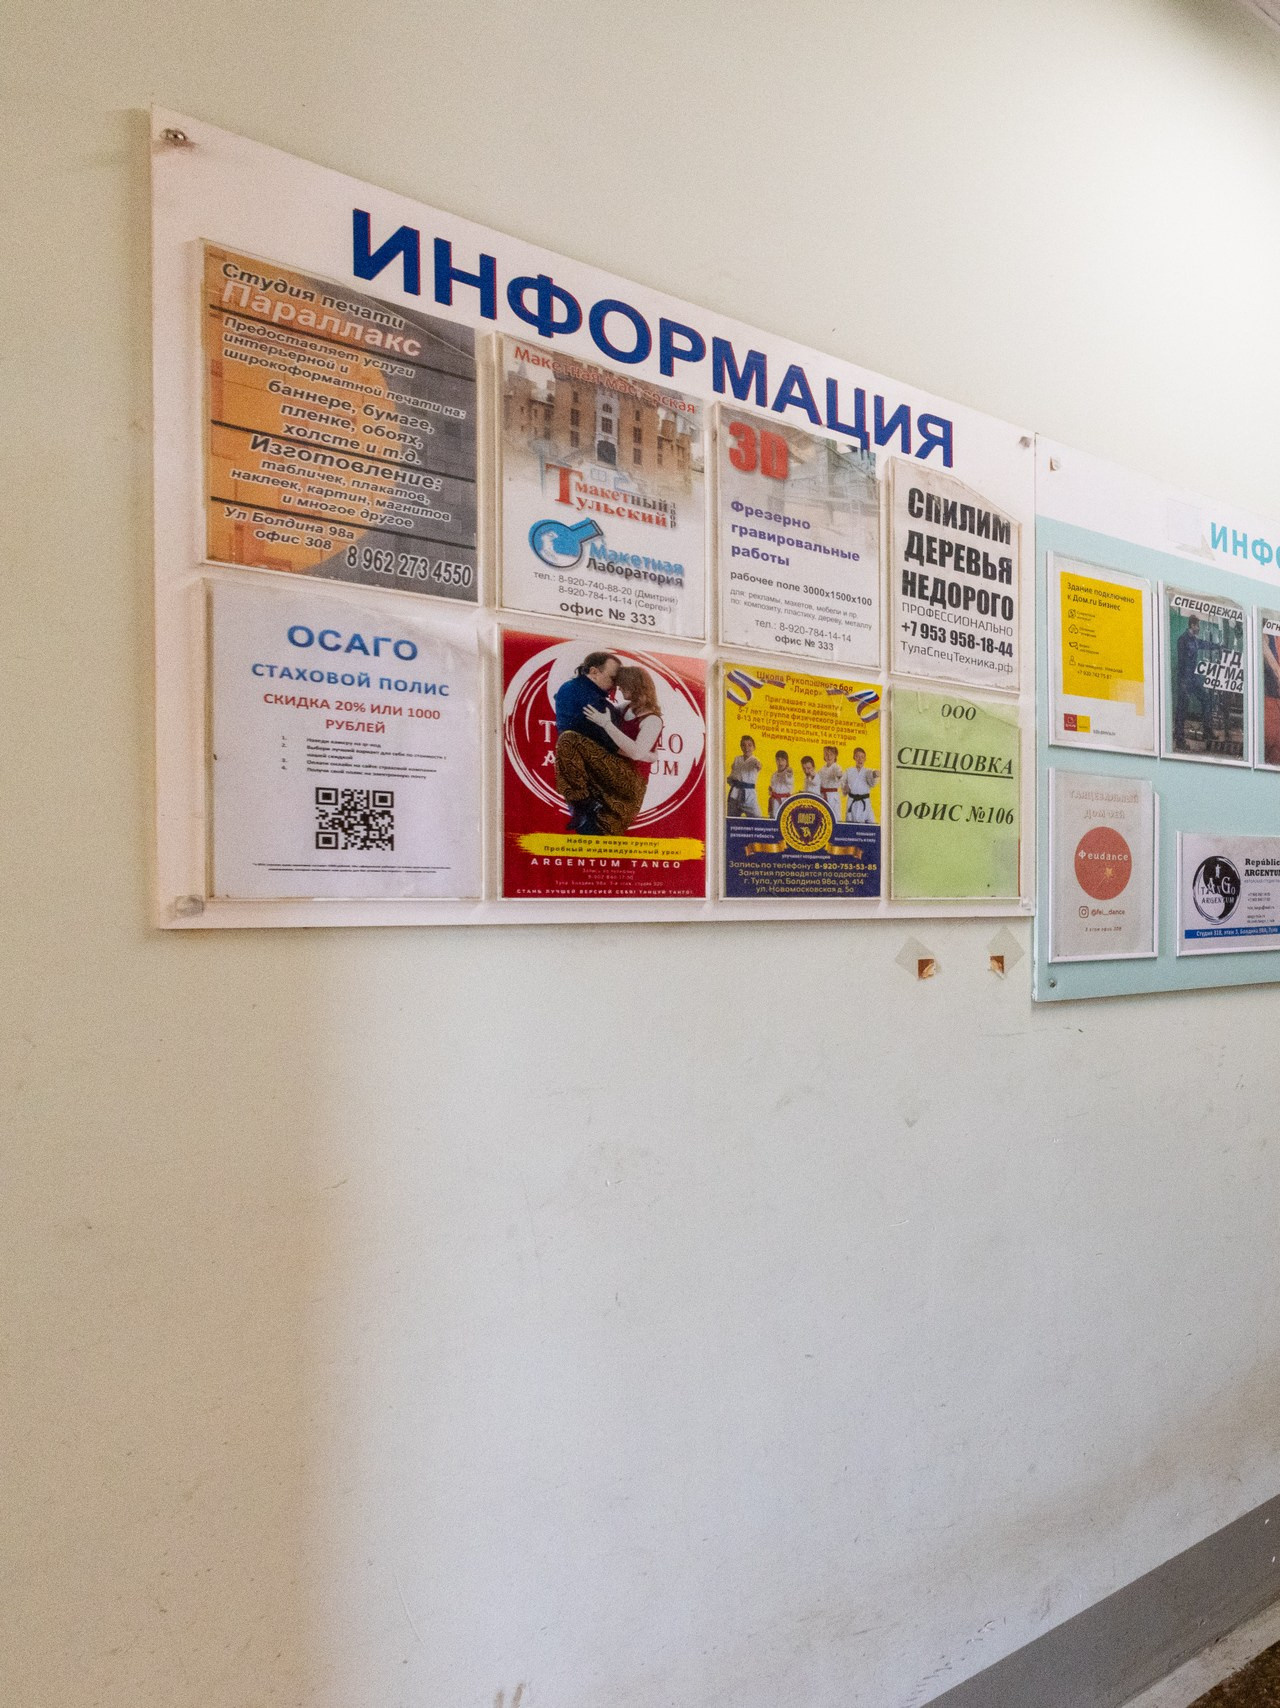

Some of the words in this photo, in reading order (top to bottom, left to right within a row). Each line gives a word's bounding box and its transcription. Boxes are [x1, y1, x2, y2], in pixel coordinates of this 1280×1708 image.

[222, 262, 316, 303] Студия
[321, 295, 405, 330] печати
[222, 279, 422, 357] Параллакс
[223, 333, 336, 374] интерьерной
[339, 363, 349, 374] и
[224, 316, 359, 363] Предоставляет
[362, 357, 415, 379] услуги
[352, 207, 954, 469] ИНФОРМАЦИЯ
[514, 346, 600, 386] Макетная
[223, 348, 382, 398] широкоформатной
[386, 391, 441, 413] печати
[444, 405, 466, 420] на:
[268, 380, 356, 414] баннере,
[362, 403, 434, 433] бумаге,
[281, 404, 356, 432] пленке,
[362, 423, 424, 448] обоях,
[283, 424, 360, 450] холсте
[366, 441, 377, 454] и
[383, 445, 421, 465] т.д.
[728, 421, 790, 481] 3D
[250, 434, 442, 491] Изготовление:
[231, 468, 301, 492] наклеек,
[306, 484, 371, 507] картин,
[375, 499, 451, 522] магнитов
[261, 460, 346, 486] табличек,
[352, 478, 430, 504] плакатов,
[545, 463, 668, 528] Тульский
[574, 480, 669, 513] макетный
[224, 506, 247, 521] Ул
[251, 512, 324, 535] Болдина
[328, 526, 355, 540] 98а
[282, 494, 292, 505] и
[297, 497, 356, 516] многое
[360, 508, 414, 529] другое
[730, 500, 811, 530] Фрезерно
[907, 487, 1011, 546] СПИЛИМ
[255, 529, 300, 546] офис
[304, 536, 332, 550] 308
[731, 523, 860, 562] гравировальные
[731, 545, 790, 567] работы
[346, 545, 357, 567] 8
[362, 548, 394, 574] 962
[398, 553, 429, 579] 273
[432, 561, 472, 587] 4550
[586, 557, 684, 588] Лаборатория
[589, 541, 686, 578] Макетная
[904, 530, 1013, 586] ДЕРЕВЬЯ
[533, 571, 556, 582] тел.:
[558, 575, 633, 596] 8-920-740-88-20
[558, 585, 633, 606] 8-920-784-14-14
[730, 571, 774, 587] рабочее
[776, 580, 801, 592] поле
[901, 569, 1014, 622] НЕДОРОГО
[1067, 582, 1093, 594] Здание
[1094, 589, 1135, 604] подключено
[559, 602, 604, 618] офис
[608, 609, 626, 621] №
[630, 611, 656, 627] 333
[902, 602, 1013, 637] ПРОФЕССИОНАЛЬНО
[1098, 599, 1121, 611] Бизнес
[1174, 596, 1243, 621] СПЕЦОДЕЖДА
[287, 625, 418, 661] ОСАГО
[775, 635, 802, 646] офис
[804, 638, 815, 648] №
[818, 640, 834, 652] 333
[780, 622, 852, 643] 8-920-784-14-14
[901, 621, 917, 637] +7
[920, 623, 947, 643] 953
[950, 629, 1014, 658] 958-18-44
[900, 640, 1014, 674] ТулаСпецТехника.рф
[1197, 661, 1244, 682] СИГМА
[1222, 650, 1242, 669] ТД
[251, 663, 371, 689] СТАХОВОЙ
[378, 676, 450, 697] ПОЛИС
[1204, 676, 1243, 692] оф.104
[263, 693, 330, 710] СКИДКА
[334, 700, 366, 714] 20%
[370, 703, 403, 717] ИЛИ
[407, 707, 441, 720] 1000
[941, 703, 977, 721] ООО
[325, 718, 386, 734] РУБЛЕЙ
[897, 746, 1014, 775] СПЕЦОВКА
[896, 800, 963, 822] ОФИС
[965, 805, 1014, 825] №106
[530, 858, 621, 867] ARGENTUM
[631, 860, 681, 868] TANGO
